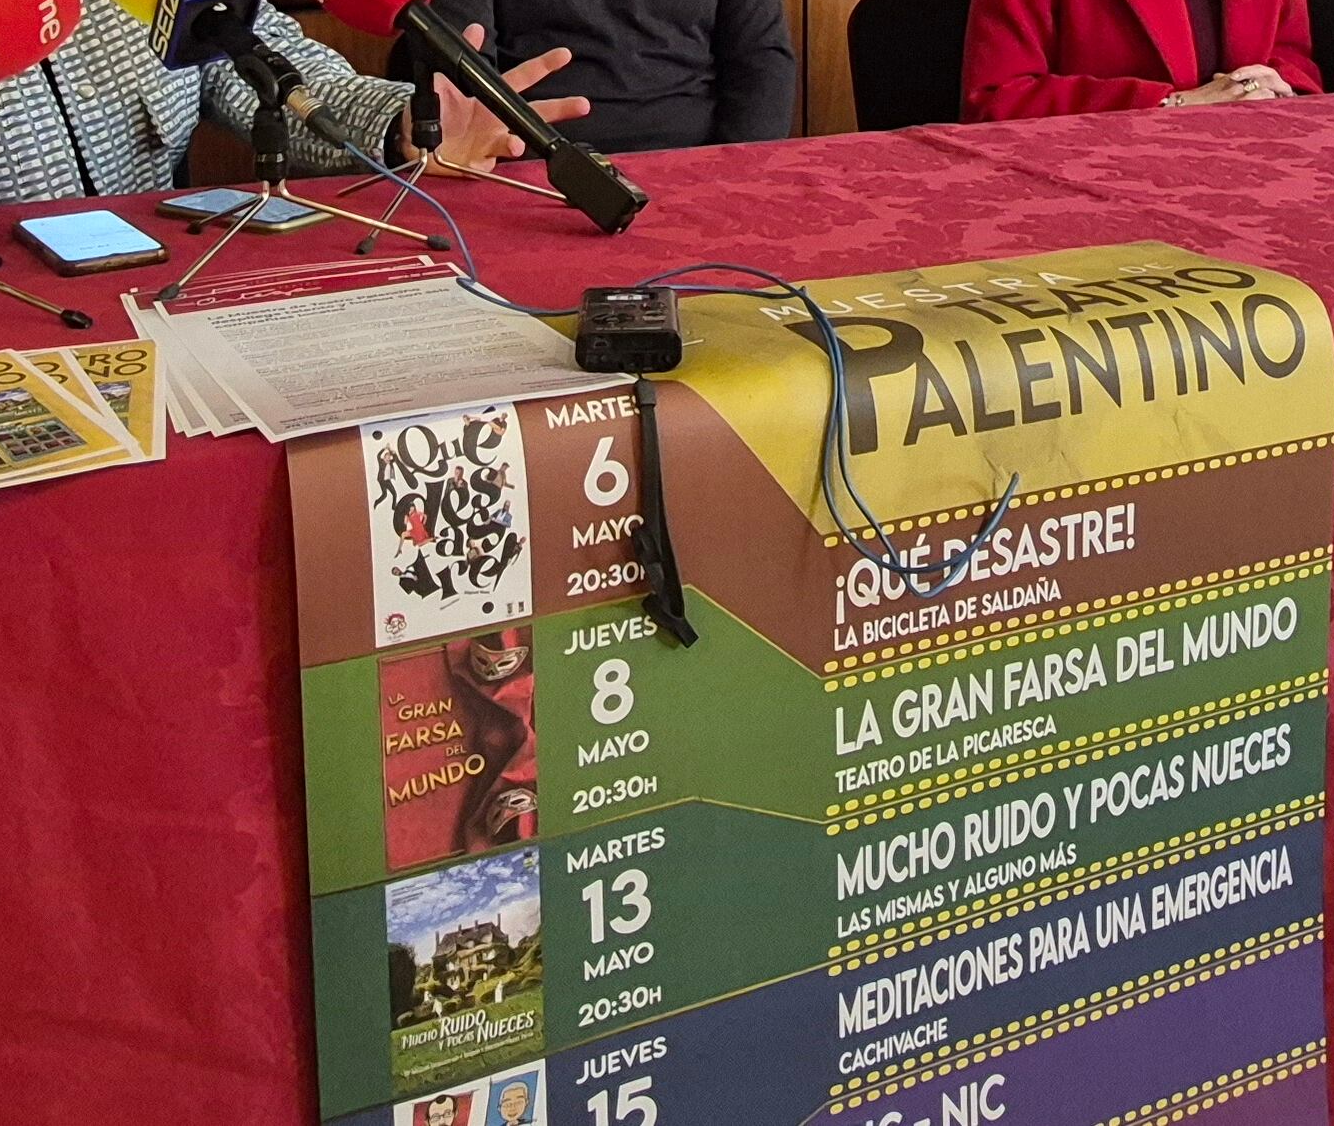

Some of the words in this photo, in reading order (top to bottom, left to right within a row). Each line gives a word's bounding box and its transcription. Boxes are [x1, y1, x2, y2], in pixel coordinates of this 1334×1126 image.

[758, 270, 1083, 323] MUESTRA
[930, 267, 1257, 325] TEATRO
[785, 292, 1307, 456] PALENTINO
[583, 436, 630, 507] 6
[572, 514, 645, 550] MAYO
[834, 535, 933, 625] ¡QUÉ
[942, 503, 1137, 583] DESASTRE!
[563, 615, 659, 656] JUEVES
[833, 627, 858, 651] LA
[863, 605, 951, 643] BICICLETA
[954, 599, 978, 621] DE
[981, 576, 1062, 617] SALDAÑA
[388, 692, 405, 706] LA
[590, 659, 635, 724] 8
[835, 699, 884, 756] LA
[892, 669, 993, 738] GRAN
[1004, 643, 1108, 711] FARSA
[1116, 629, 1174, 685] DEL
[1181, 596, 1298, 667] MUNDO
[398, 698, 453, 721] GRAN
[385, 720, 464, 756] FARSA
[445, 743, 467, 758] DEL
[578, 730, 650, 768] MAYO
[835, 754, 904, 794] TEATRO
[909, 749, 933, 772] DE
[935, 743, 959, 765] LA
[963, 714, 1057, 759] PICARESCA
[388, 753, 486, 807] MUNDO
[572, 775, 658, 814] 20:30H
[836, 821, 957, 901] MUCHO
[964, 792, 1057, 862] RUIDO
[1063, 783, 1085, 830] Y
[1090, 755, 1185, 824] POCAS
[1192, 722, 1292, 792] NUECES
[567, 826, 666, 874] MARTES
[581, 868, 653, 944] 13
[837, 910, 871, 939] LAS
[875, 890, 945, 927] MISMAS
[947, 881, 959, 902] Y
[963, 855, 1037, 897] ALGUNO
[1040, 842, 1078, 872] MÁS
[584, 941, 655, 982] MAYO
[838, 931, 1024, 1039] MEDITACIONES
[1028, 910, 1091, 974] PARA
[1096, 891, 1147, 950] UNA
[1151, 844, 1294, 933] EMERGENCIA
[439, 1009, 487, 1039] RUIDO
[476, 1010, 535, 1043] NUECES
[578, 985, 662, 1028] 20:30H
[575, 1035, 668, 1086] JUEVES
[838, 1017, 949, 1075] CACHIVACHE
[587, 1075, 659, 1126] 15
